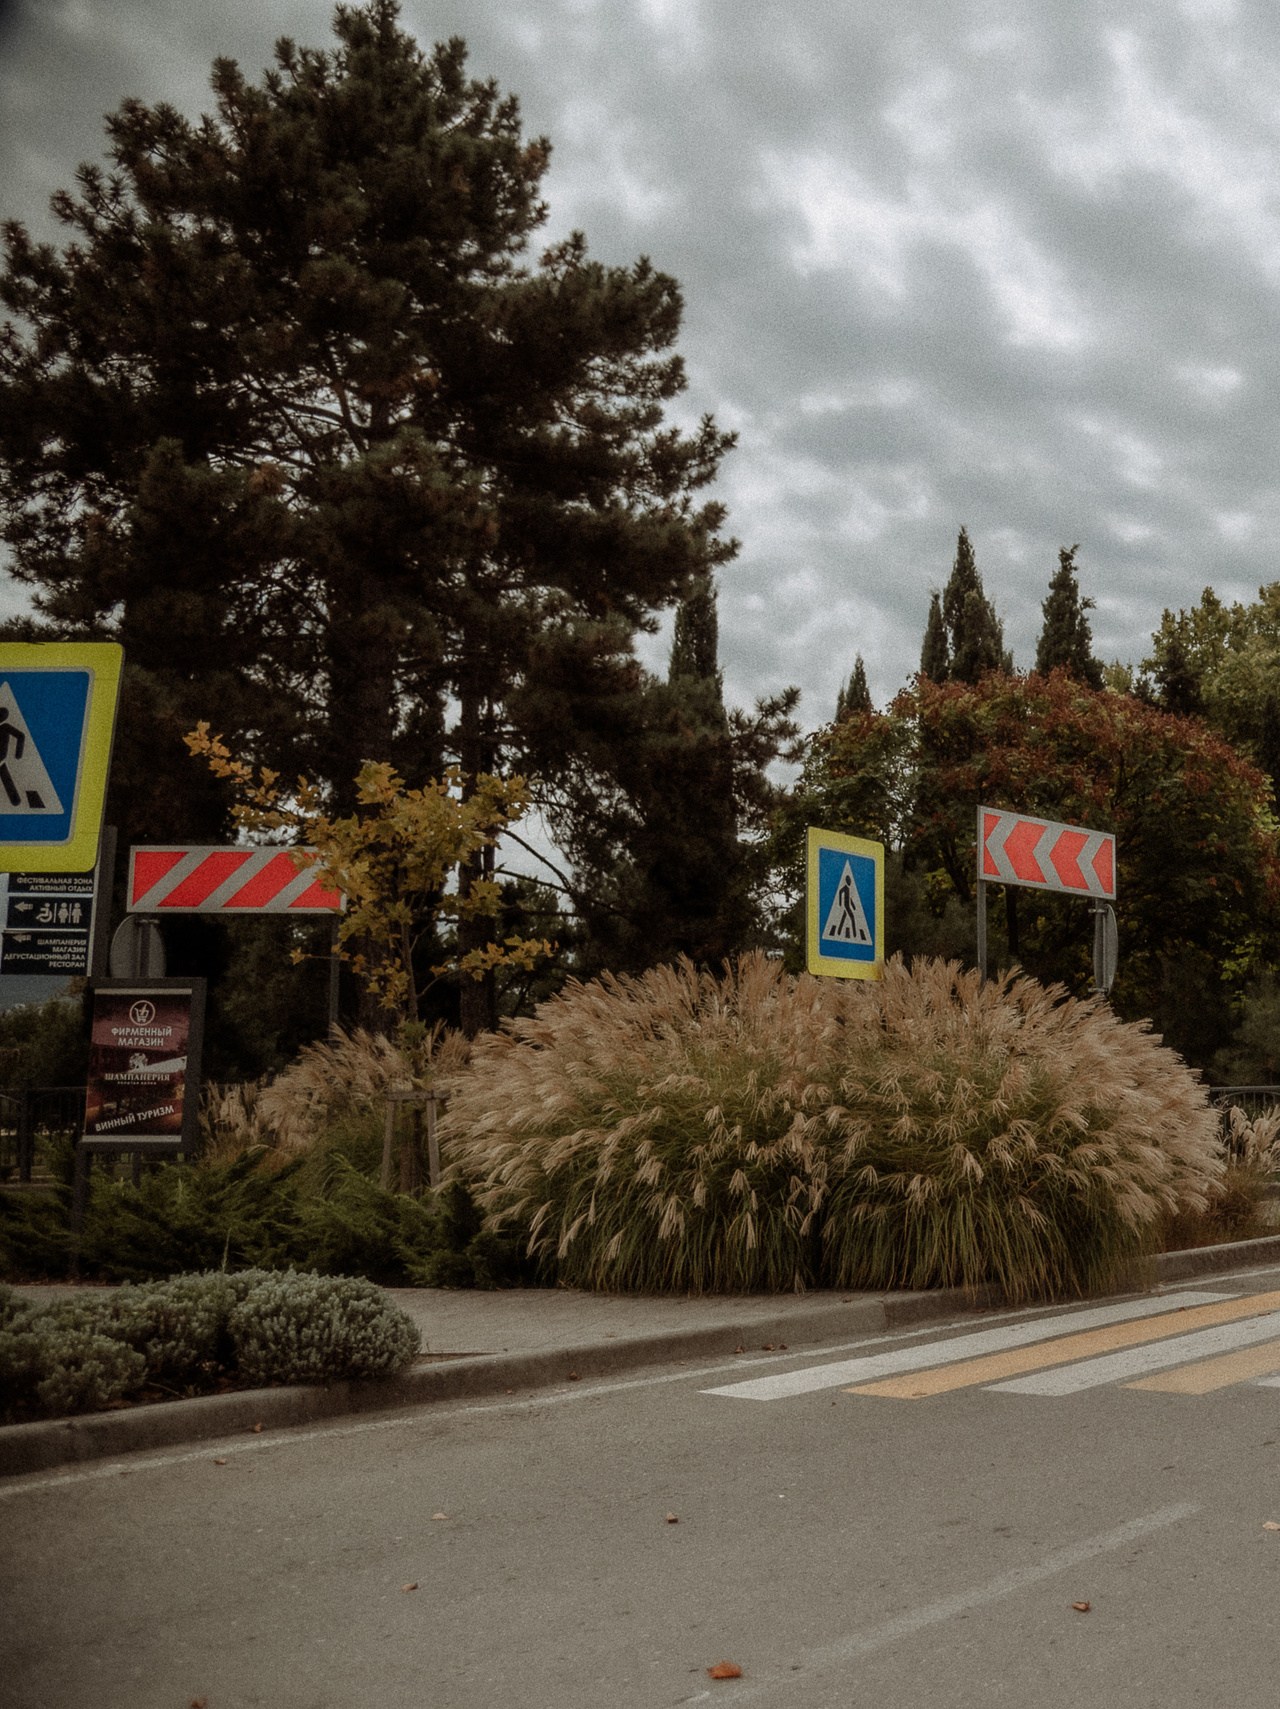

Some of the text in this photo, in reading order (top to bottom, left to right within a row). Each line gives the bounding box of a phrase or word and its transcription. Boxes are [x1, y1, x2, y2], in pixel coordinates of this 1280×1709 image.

[111, 1026, 172, 1036] ФИРМЕННЫЙ
[118, 1038, 164, 1047] МАГАЗИН
[105, 1073, 170, 1081] ШАМПАНЕРИЯ
[95, 1105, 174, 1132] ВИННЫЙ ТУРИЗМ
